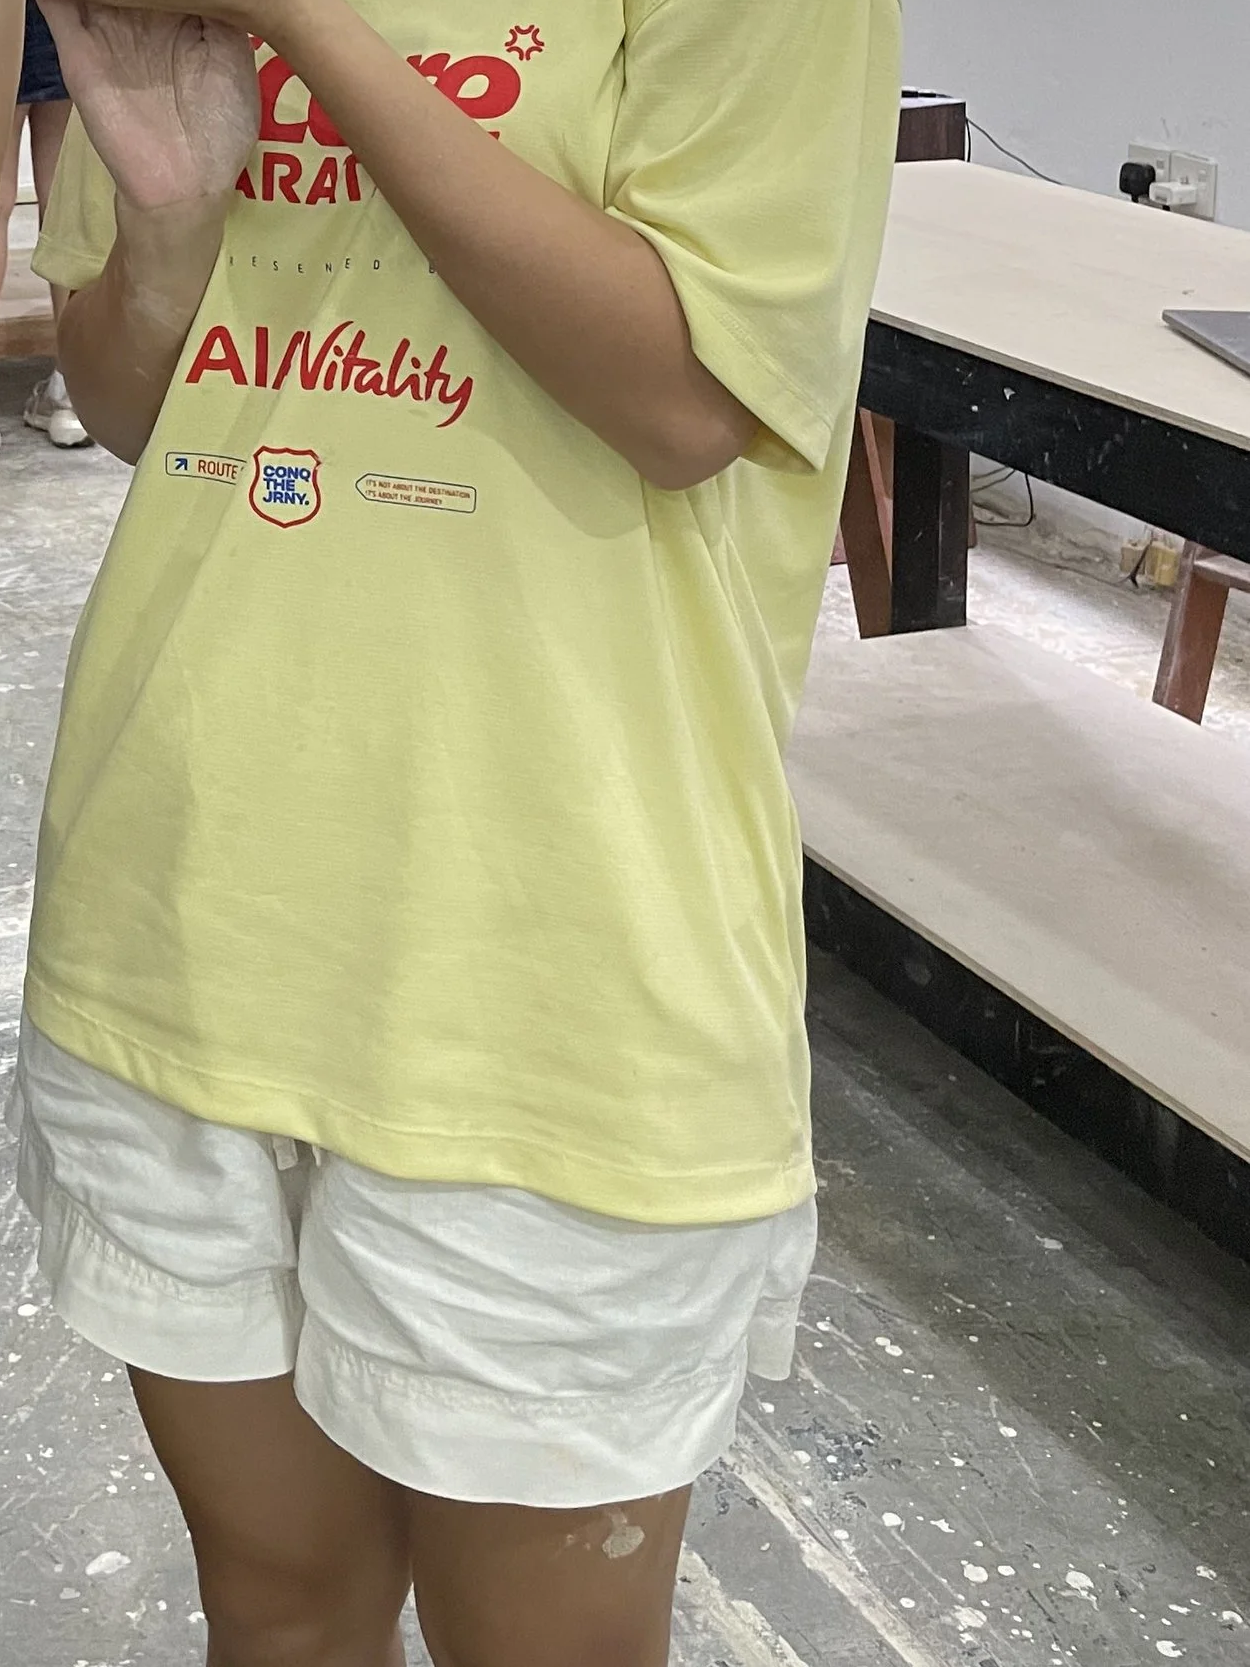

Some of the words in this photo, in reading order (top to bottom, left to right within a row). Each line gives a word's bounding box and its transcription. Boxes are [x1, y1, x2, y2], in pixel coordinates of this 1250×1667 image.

[198, 459, 239, 480] ROUTE
[263, 465, 311, 483] CONQ
[263, 478, 296, 492] THE
[392, 483, 413, 492] ABOUT
[262, 491, 310, 506] JRNY.
[378, 492, 398, 500] ABOUT
[400, 494, 411, 502] THE
